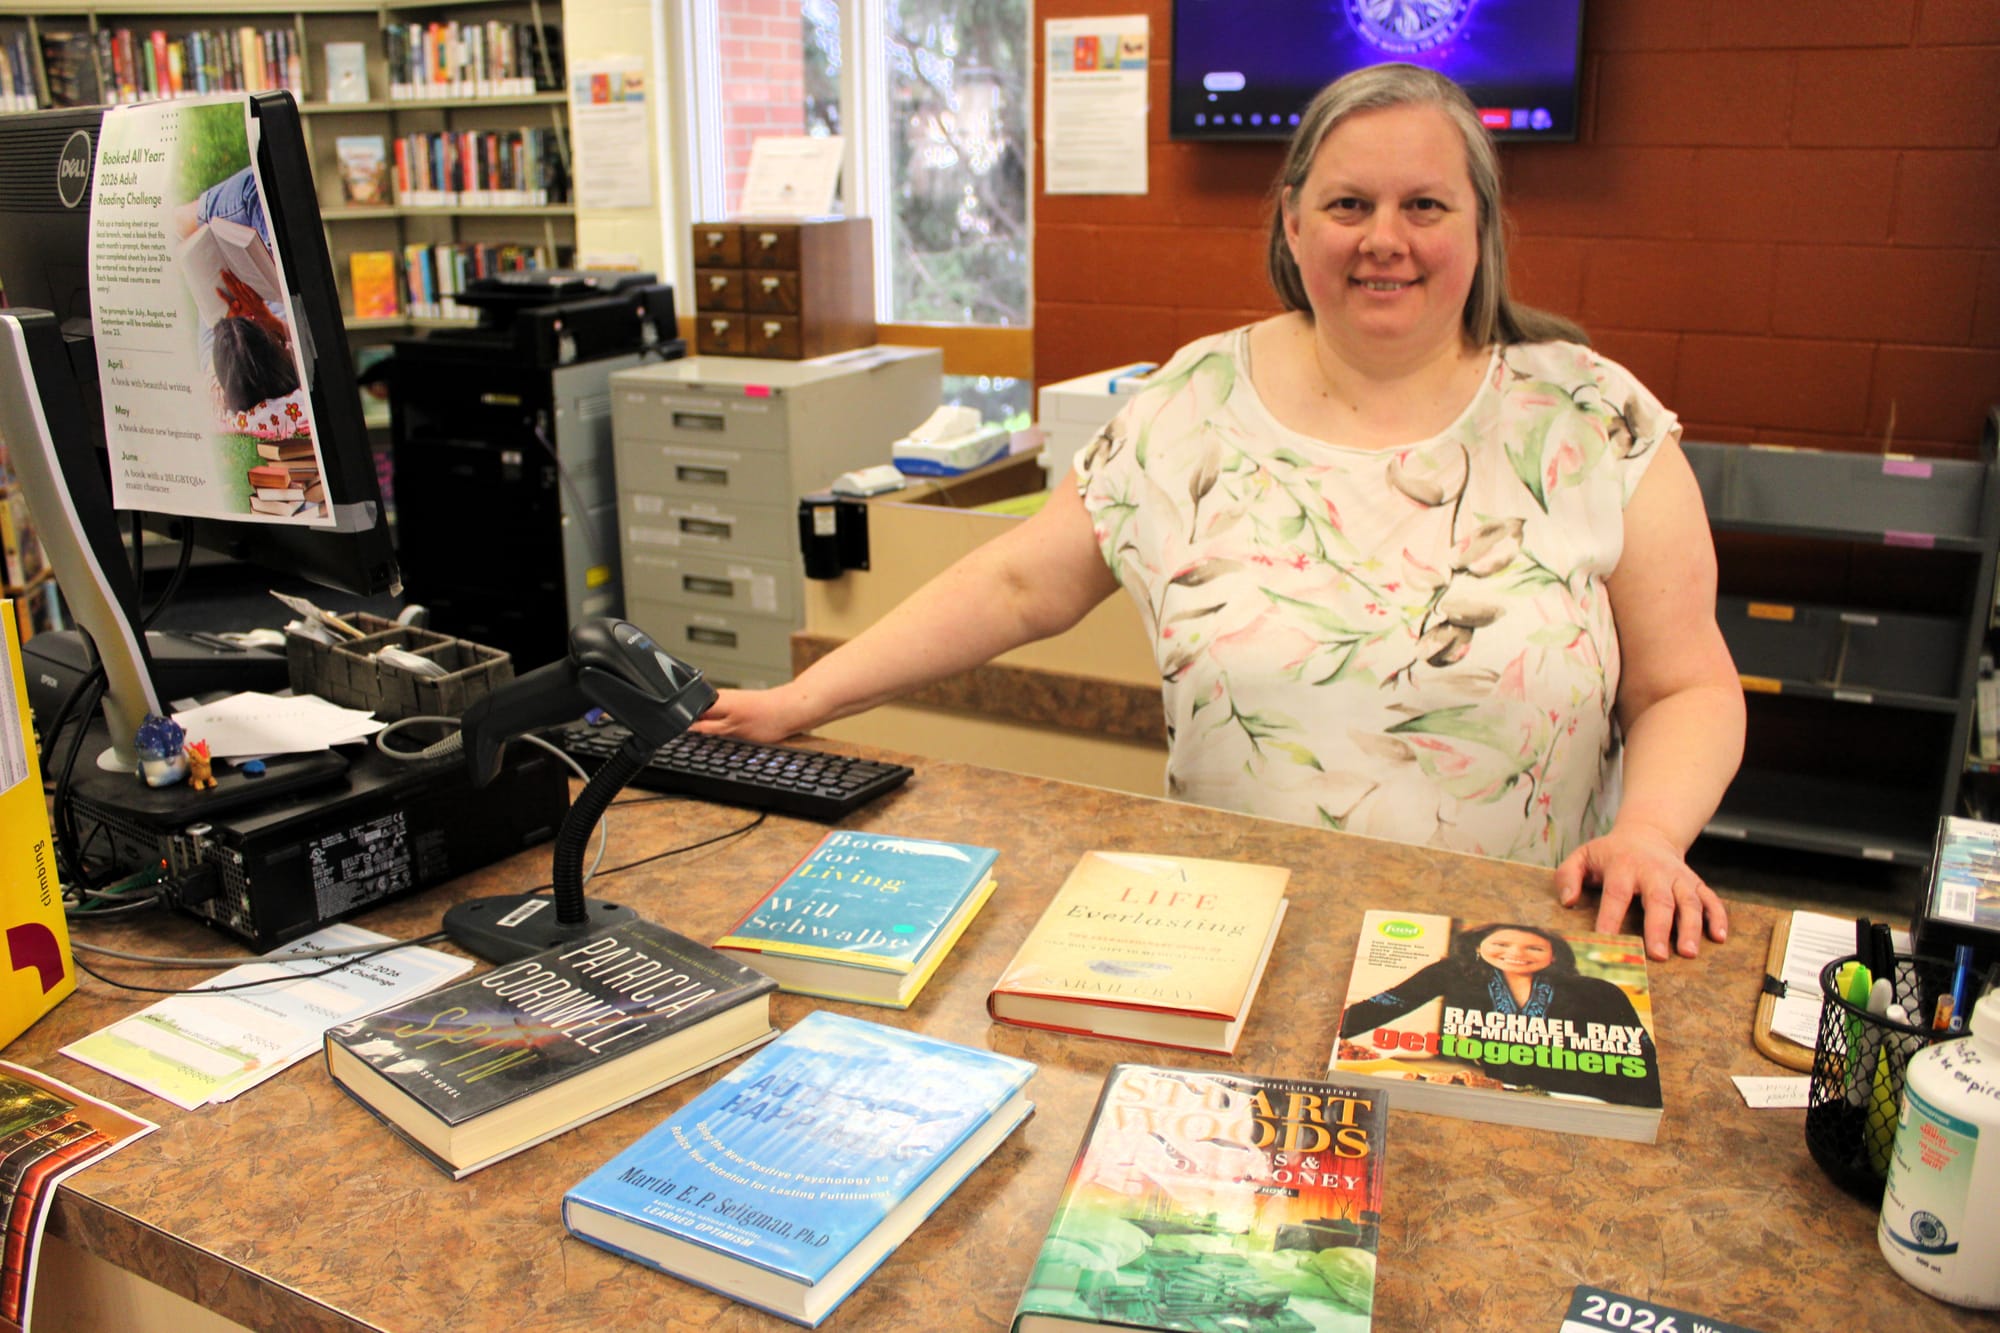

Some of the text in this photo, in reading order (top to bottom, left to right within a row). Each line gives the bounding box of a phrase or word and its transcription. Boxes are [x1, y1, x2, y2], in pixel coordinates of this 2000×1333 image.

[61, 158, 86, 178] DELL
[102, 148, 165, 165] Booked All Year:
[100, 172, 138, 186] 2026 Adult
[98, 191, 162, 208] Reading Challenge
[107, 358, 123, 372] April
[114, 404, 130, 418] May
[121, 451, 139, 461] June
[812, 848, 861, 865] for
[33, 840, 52, 907] climbing
[798, 864, 906, 894] Living
[770, 896, 841, 919] Will
[1120, 887, 1220, 911] LIFE
[745, 914, 911, 950] Schwalbe
[1065, 904, 1247, 937] Everlasting
[1384, 924, 1419, 936] food
[349, 967, 397, 987] Challenge
[374, 964, 401, 978] 2026
[558, 937, 717, 1019] PATRICIA
[1037, 976, 1194, 1001] SARAH GRAY
[481, 963, 648, 1054] CORNWELL
[1445, 1007, 1645, 1044] RACHAEL RAY
[395, 1006, 539, 1084] SPIN
[1443, 1023, 1643, 1056] 30-MINUTE MEALS
[432, 1078, 462, 1099] NOVEL
[1319, 1086, 1359, 1098] AUTHOR
[671, 1125, 891, 1201] Realize Your Potential for Lasting Fulfillment
[710, 1138, 726, 1152] the
[724, 1148, 746, 1164] New
[746, 1159, 792, 1180] Positive
[795, 1173, 872, 1186] Psychology
[876, 1175, 889, 1183] to
[1301, 1156, 1320, 1170] &
[1271, 1170, 1361, 1191] ONEY
[616, 1166, 677, 1197] Martin
[676, 1184, 698, 1204] E.
[695, 1191, 717, 1209] P.
[712, 1197, 794, 1240] Seligman,
[642, 1205, 756, 1248] LEARNED OPTIMISM
[1581, 1295, 1679, 1333] 2026
